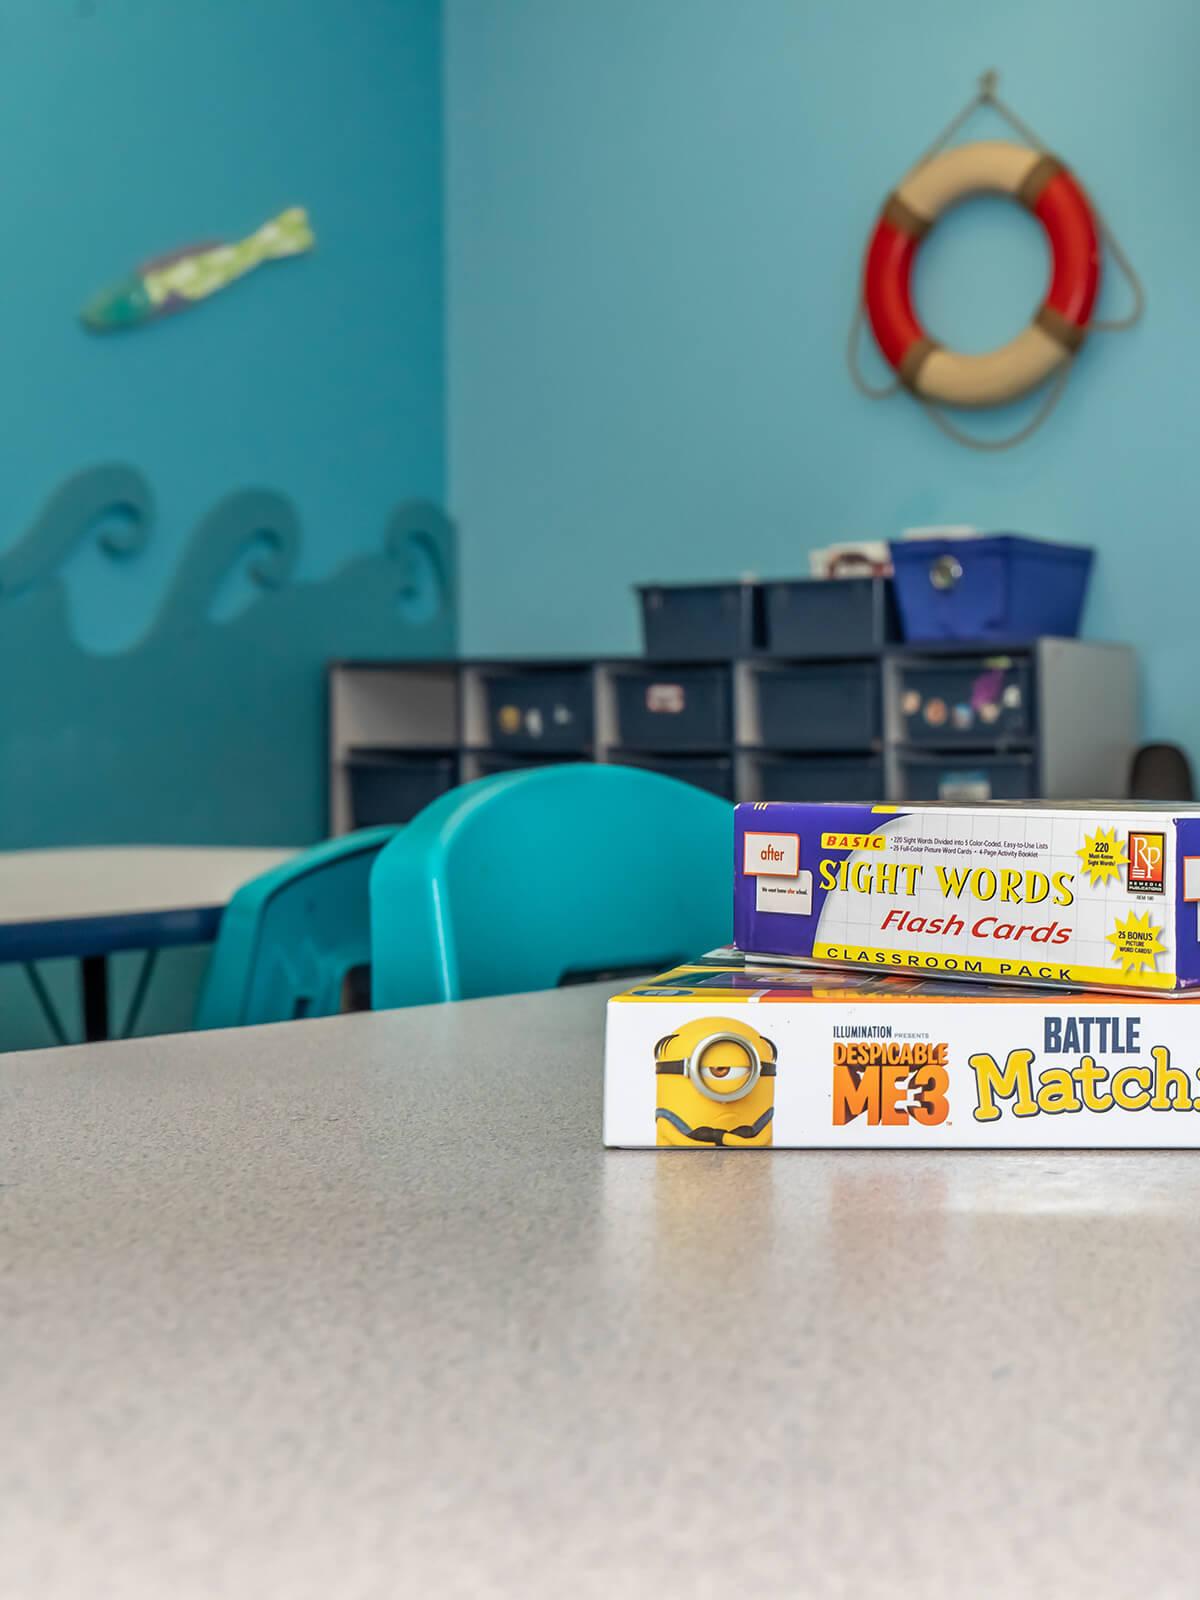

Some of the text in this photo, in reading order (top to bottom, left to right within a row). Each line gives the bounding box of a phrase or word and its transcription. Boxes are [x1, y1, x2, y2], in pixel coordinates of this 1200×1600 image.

[826, 836, 883, 848] BASIC
[903, 837, 917, 845] Sight
[1004, 841, 1035, 850] Easy-to-Use
[1036, 842, 1048, 850] Lists
[1095, 842, 1109, 853] 220
[760, 844, 784, 861] after
[980, 850, 996, 858] 4-Page
[819, 859, 1075, 906] SIGHT WORDS
[880, 909, 1072, 944] Flash Cards
[1118, 931, 1153, 941] 25 BONUS
[827, 948, 1072, 980] CLASSROOM PACK
[833, 1026, 892, 1038] ILLUMINATION
[1044, 1017, 1141, 1054] BATTLE
[833, 1042, 949, 1066] DESPICABLE
